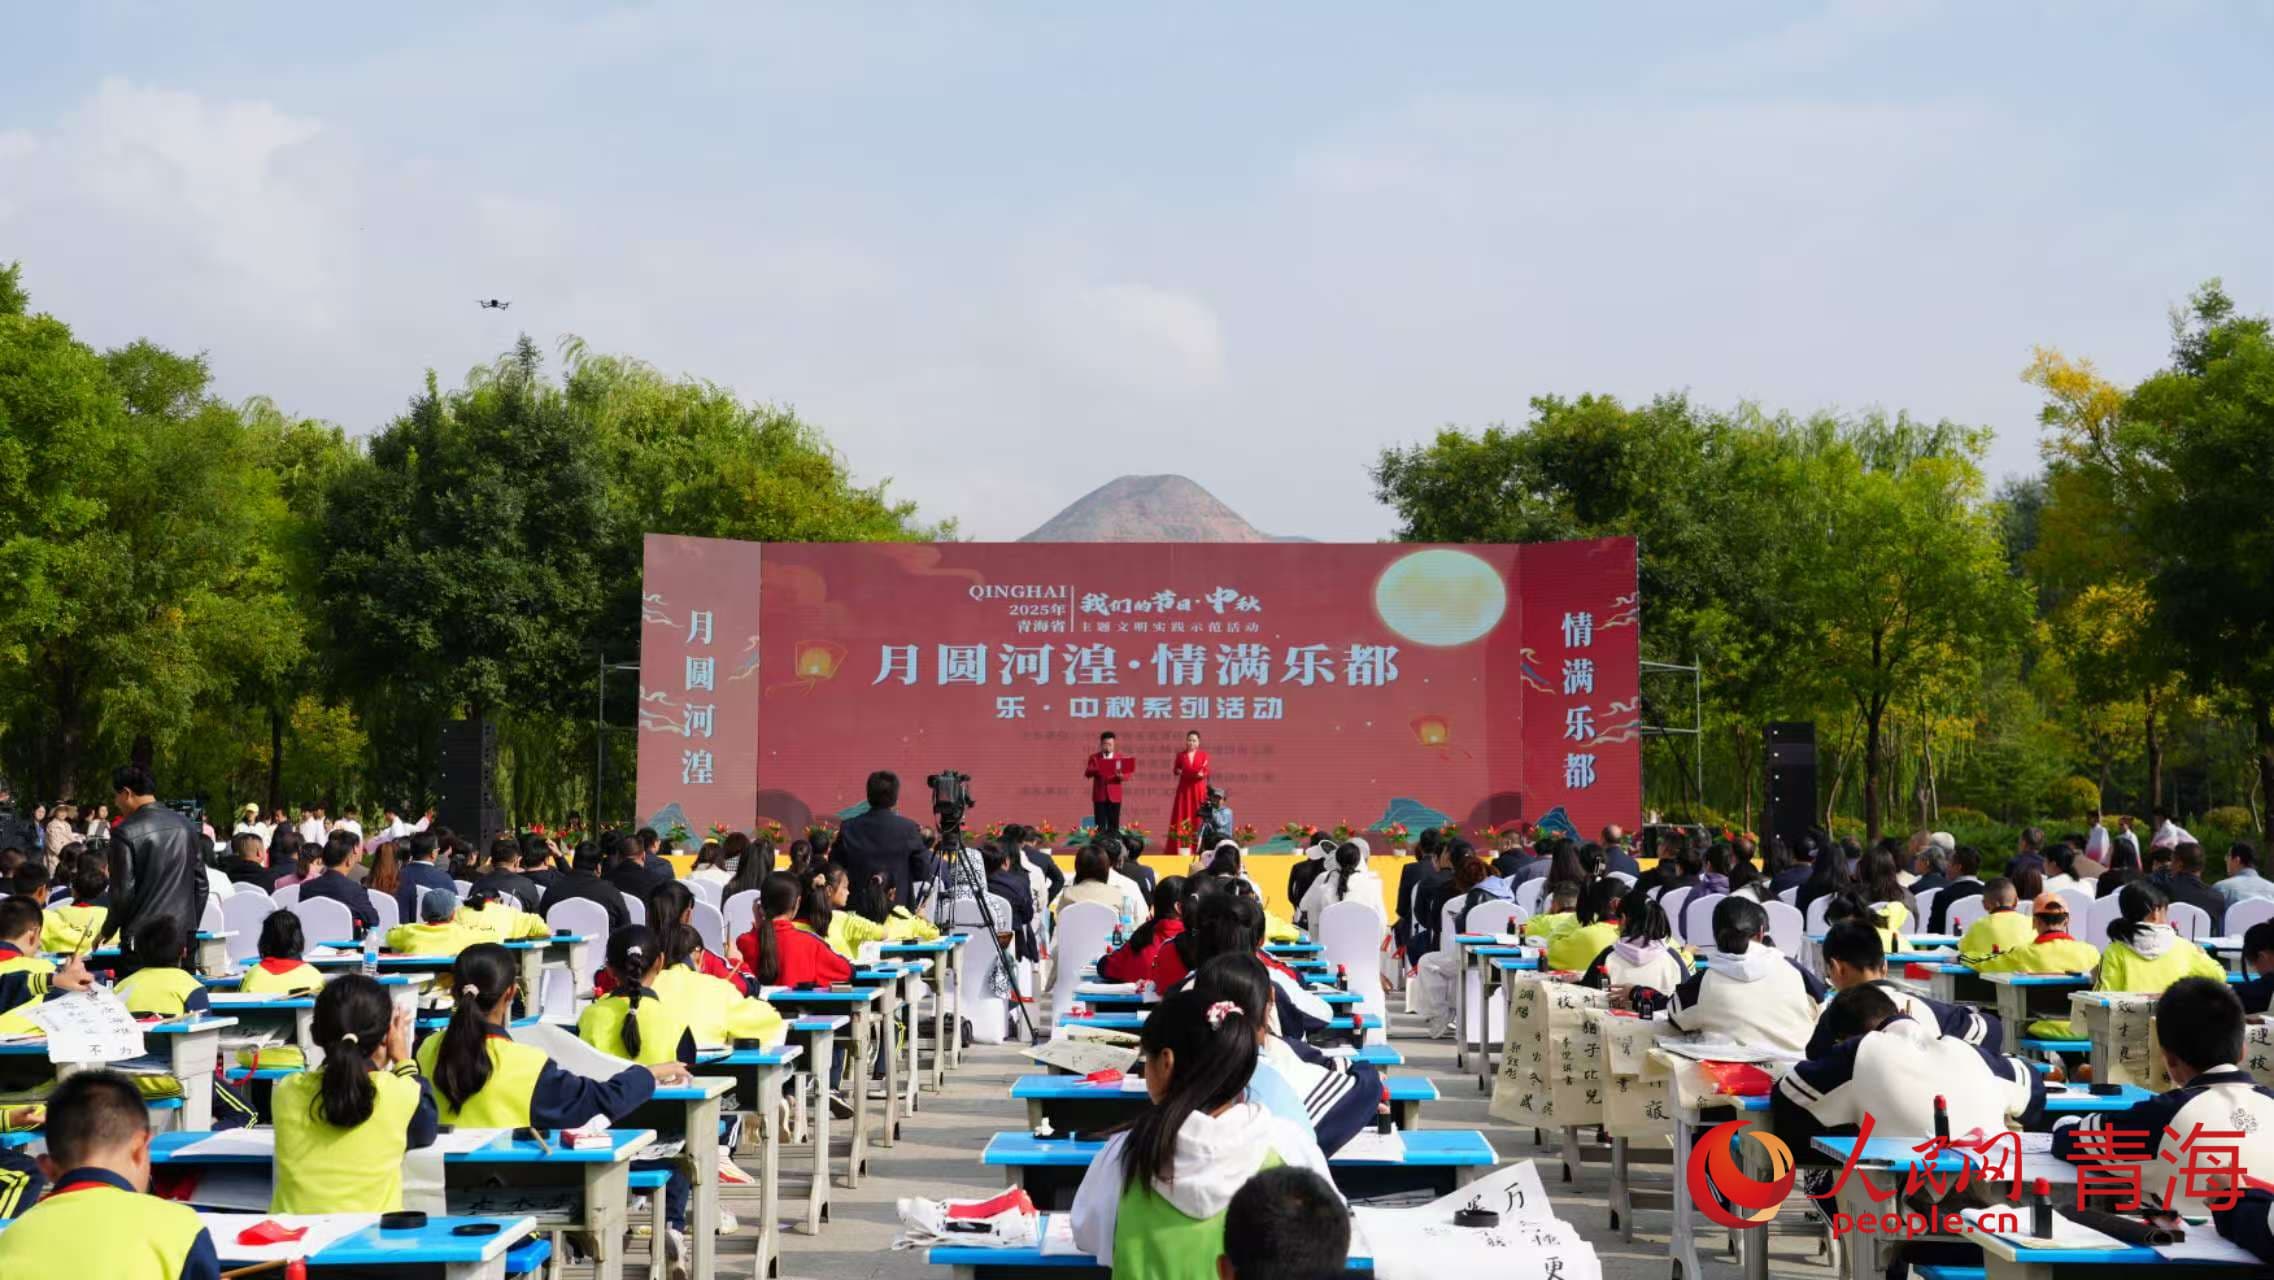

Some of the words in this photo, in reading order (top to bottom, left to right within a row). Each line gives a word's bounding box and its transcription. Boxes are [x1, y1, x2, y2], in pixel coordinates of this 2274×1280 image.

[969, 584, 1066, 601] QINGHAI
[1009, 603, 1066, 616] 2025年
[1017, 619, 1066, 633] 青海省
[1081, 621, 1260, 633] 主题文明实践示范活动
[872, 642, 1399, 687] 月圆河湟·情满乐都
[682, 610, 715, 784] 月圆河湟
[1561, 612, 1596, 789] 情满乐都
